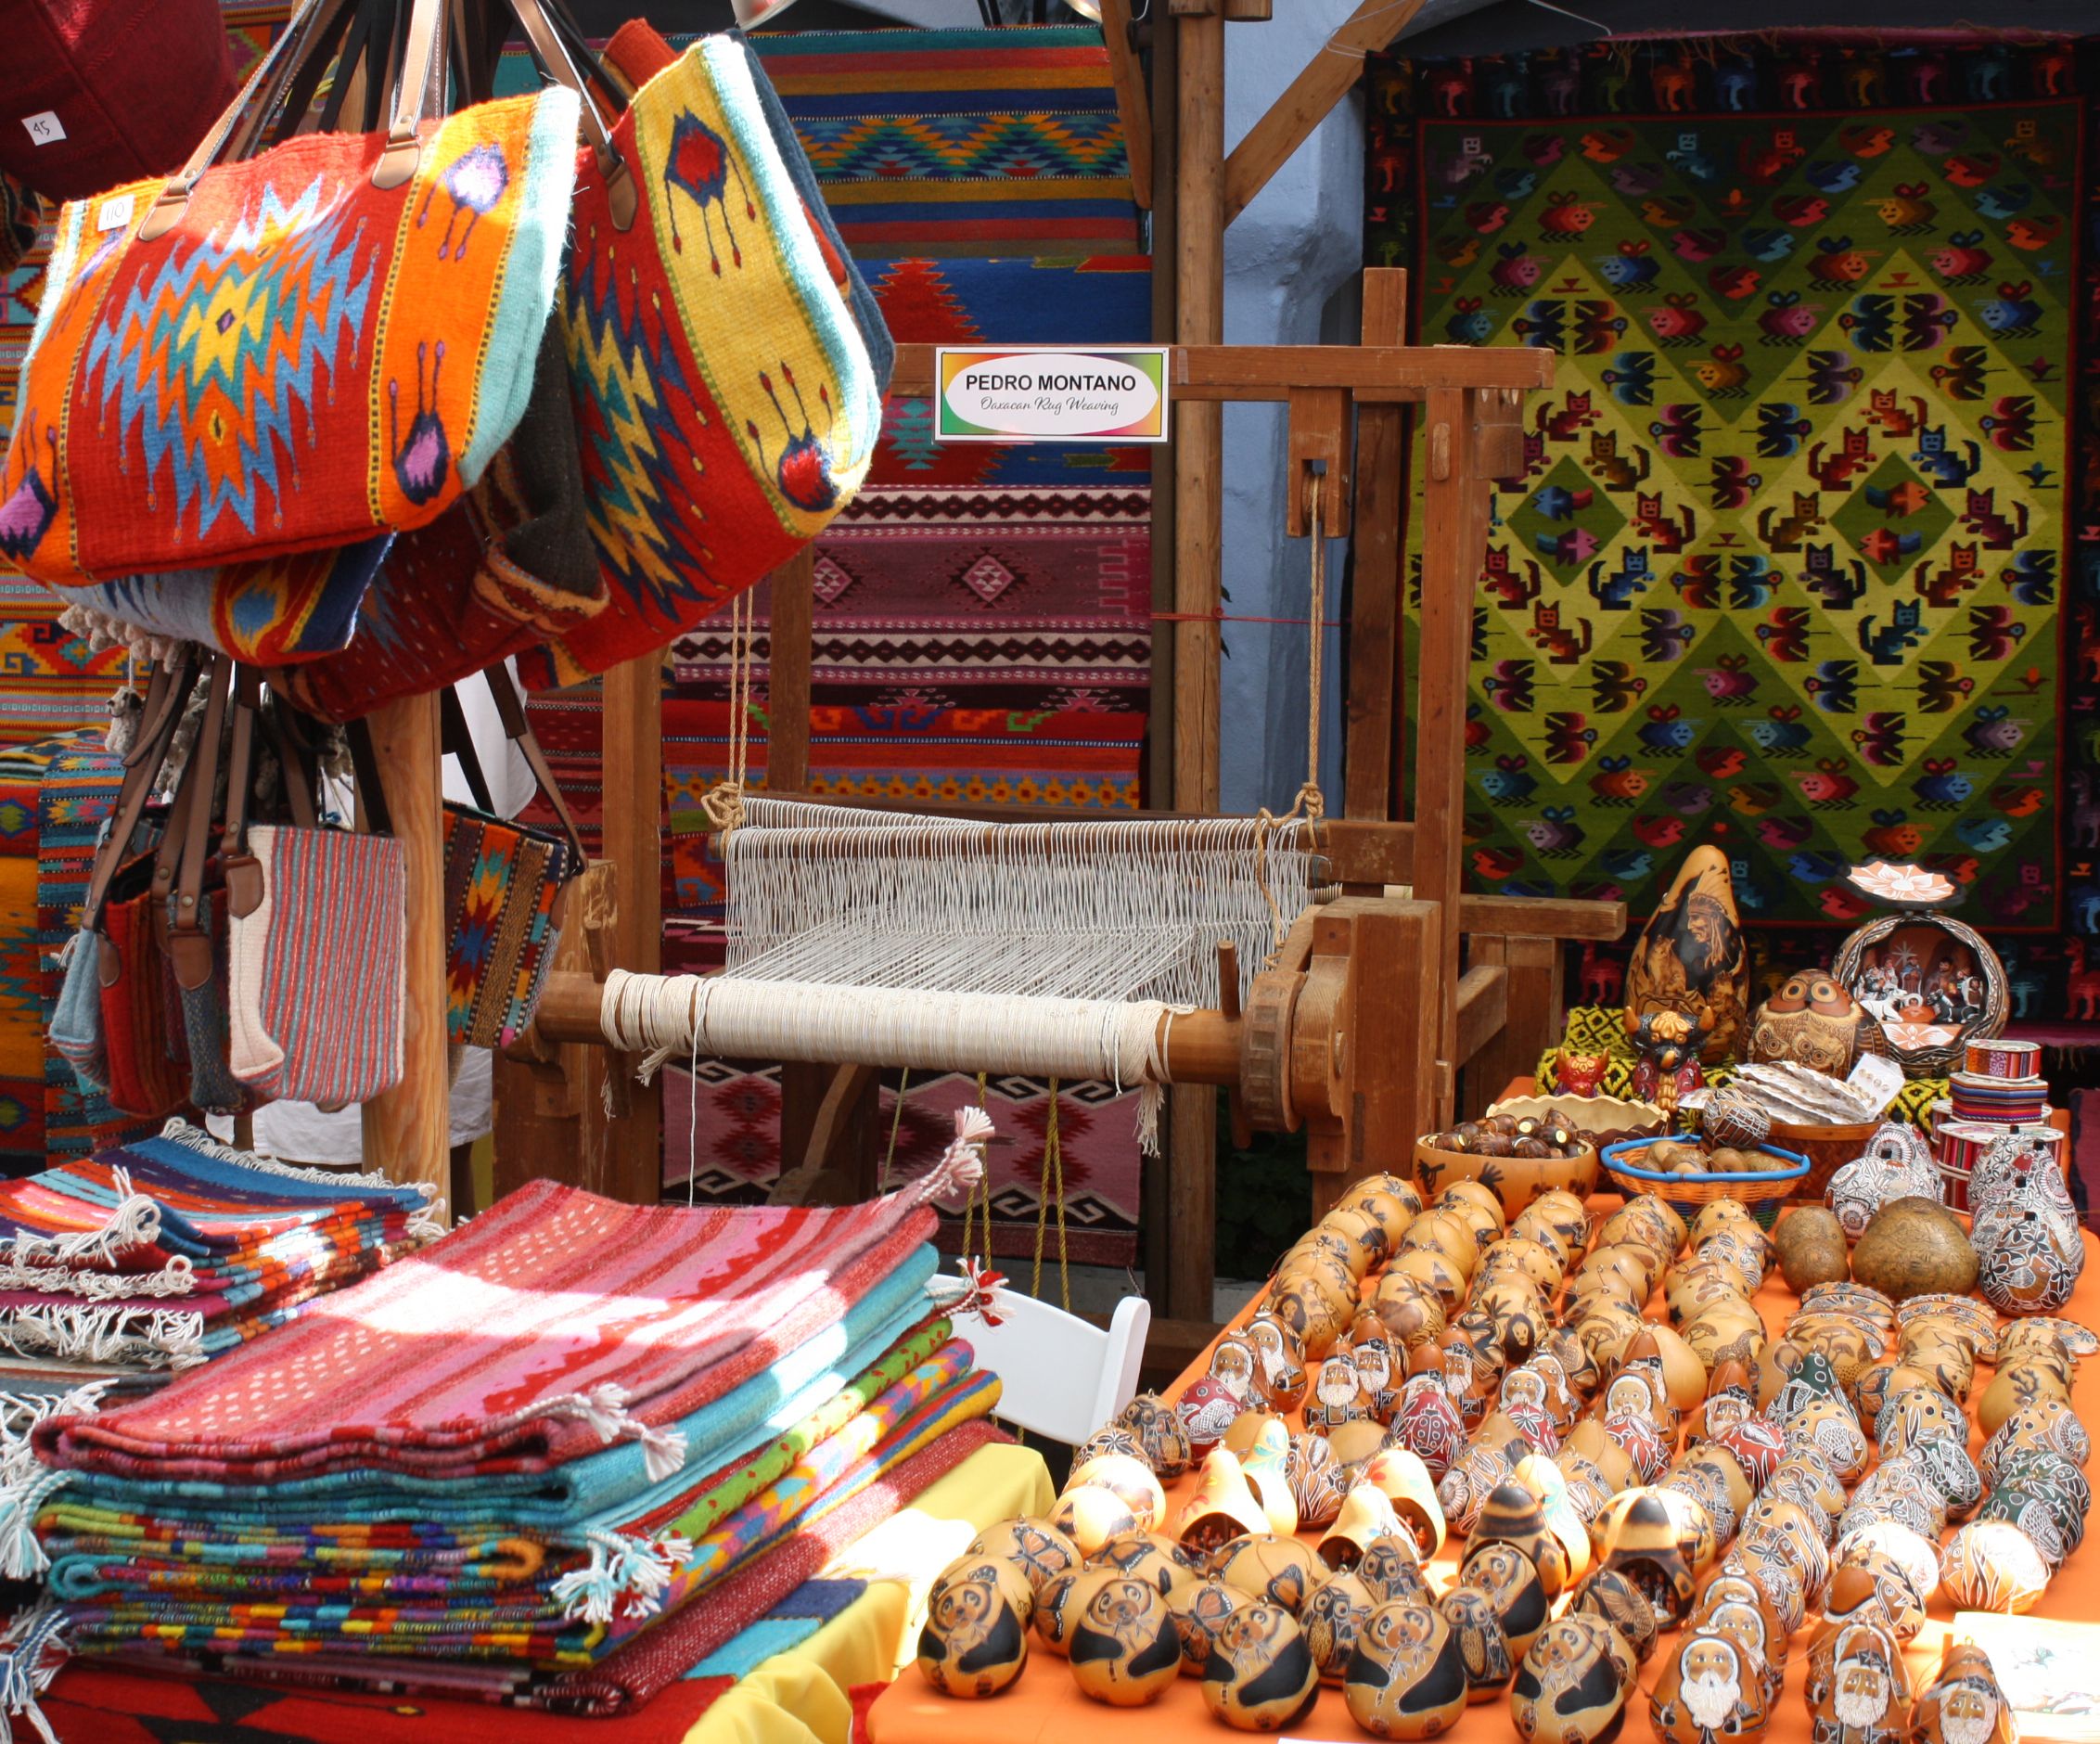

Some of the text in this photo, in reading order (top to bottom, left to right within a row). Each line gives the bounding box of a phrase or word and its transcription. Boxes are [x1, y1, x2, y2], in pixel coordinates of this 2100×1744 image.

[33, 120, 50, 135] 45
[107, 202, 125, 223] 110
[966, 375, 1136, 391] PEDRO MONTANO
[980, 396, 1119, 416] Oaxacan Rug Weaving
